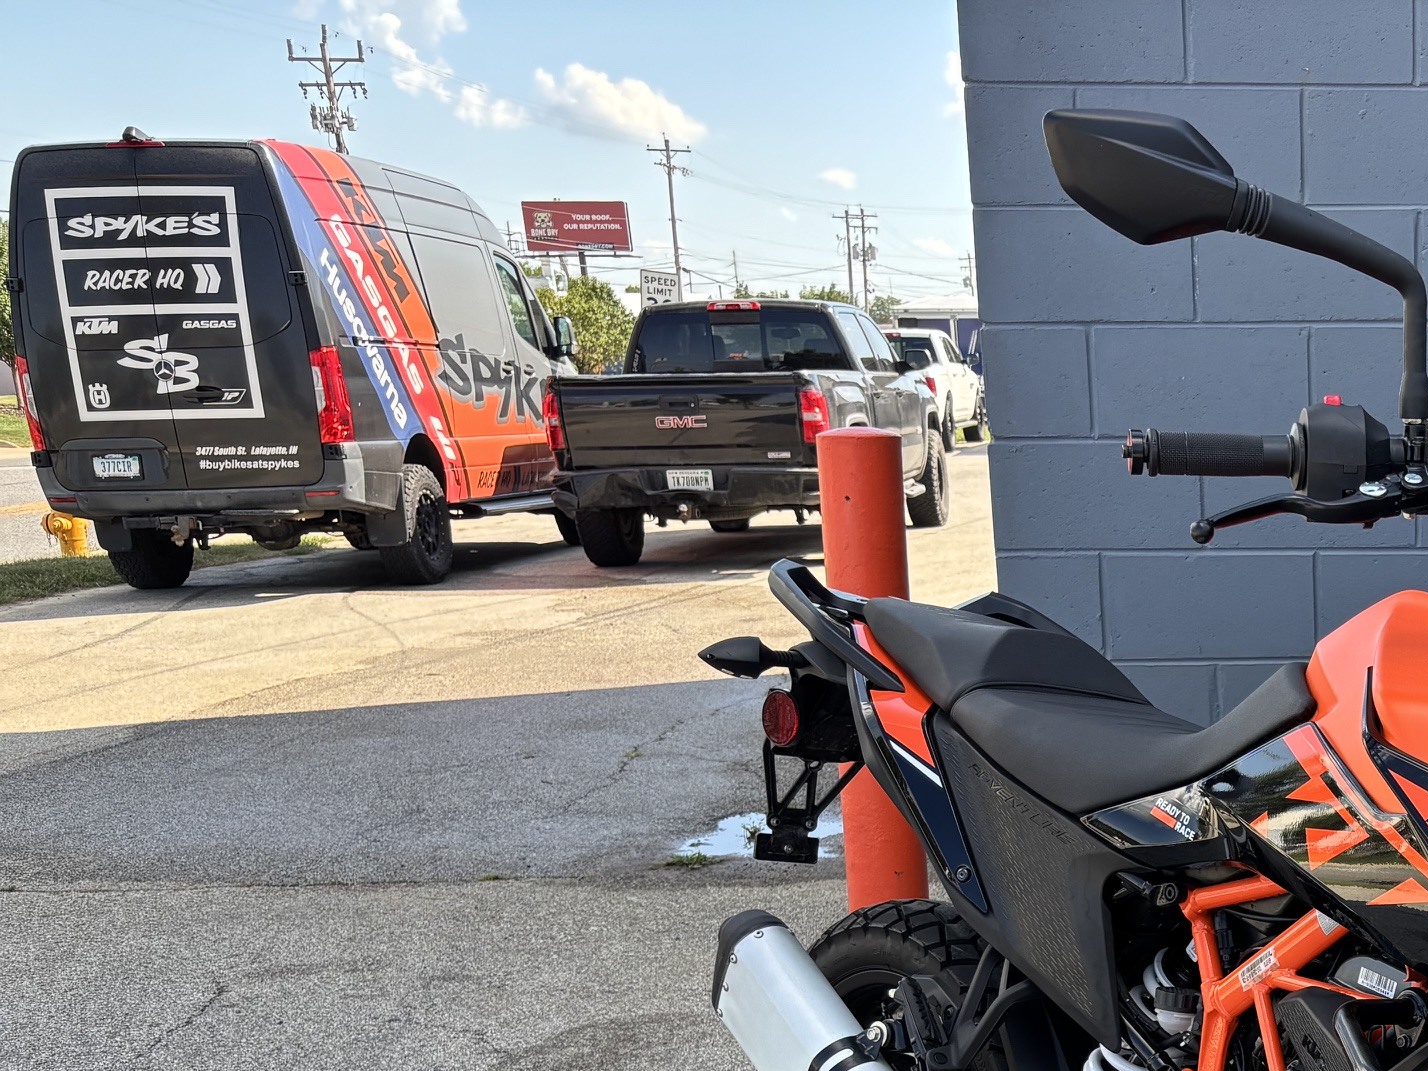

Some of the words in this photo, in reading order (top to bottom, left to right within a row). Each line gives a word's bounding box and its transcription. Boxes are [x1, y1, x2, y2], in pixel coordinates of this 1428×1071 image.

[64, 212, 221, 240] SPYKE'S
[336, 178, 410, 303] KTM
[84, 269, 151, 290] RACER
[155, 268, 185, 290] HQ
[644, 276, 676, 287] SPEED
[647, 286, 672, 297] LIMIT
[328, 213, 425, 395] GASGAS
[75, 318, 119, 335] KTM
[182, 320, 237, 329] GASGAS
[320, 248, 407, 430] Husqvarna
[437, 333, 546, 424] SPYK
[655, 415, 707, 429] GMC
[195, 447, 213, 456] 3477
[213, 446, 236, 456] South
[237, 446, 247, 455] St.
[251, 445, 288, 456] Lafayette,
[289, 445, 298, 455] IN
[101, 460, 132, 473] 377CIR
[199, 459, 300, 472] #buybikesatspykes
[1155, 797, 1182, 819] READY
[1179, 811, 1191, 826] TO
[1174, 821, 1196, 842] RACE
